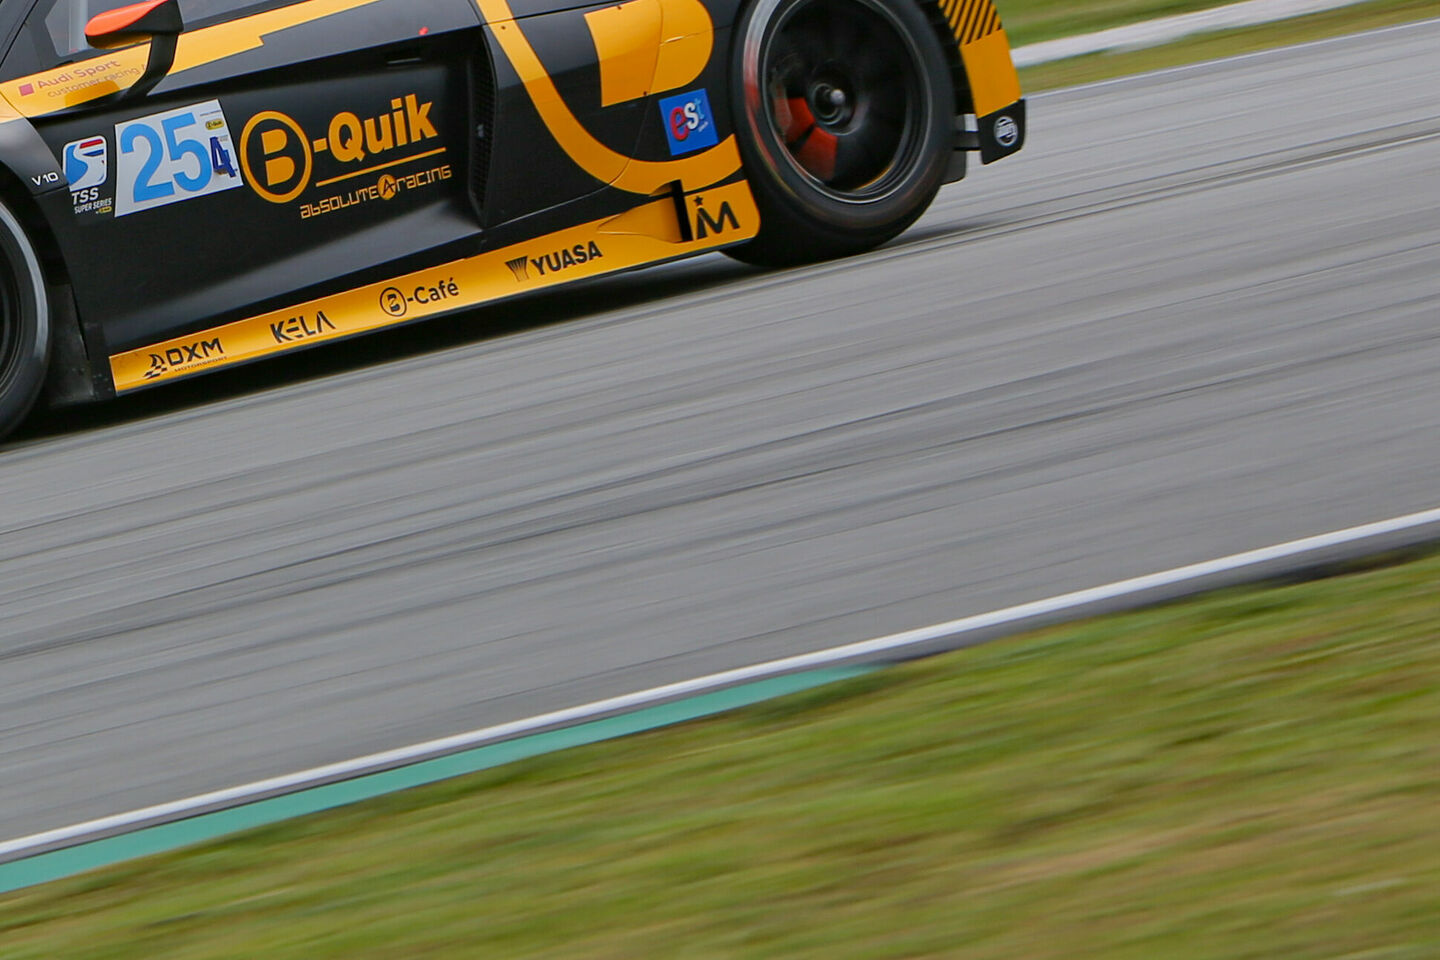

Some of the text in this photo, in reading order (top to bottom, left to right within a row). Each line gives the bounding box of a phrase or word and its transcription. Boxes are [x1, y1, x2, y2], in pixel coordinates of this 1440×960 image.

[37, 70, 73, 89] Audi
[74, 59, 121, 80] Sport
[47, 77, 106, 98] customer
[105, 67, 141, 85] racing
[120, 112, 212, 204] 25
[209, 136, 237, 179] 4
[239, 93, 439, 204] B-Quik
[31, 171, 59, 186] V10
[71, 187, 100, 206] TSS
[531, 240, 603, 276] YUASA
[379, 277, 460, 317] B-Café
[269, 310, 337, 344] KELA
[165, 337, 224, 367] DXM
